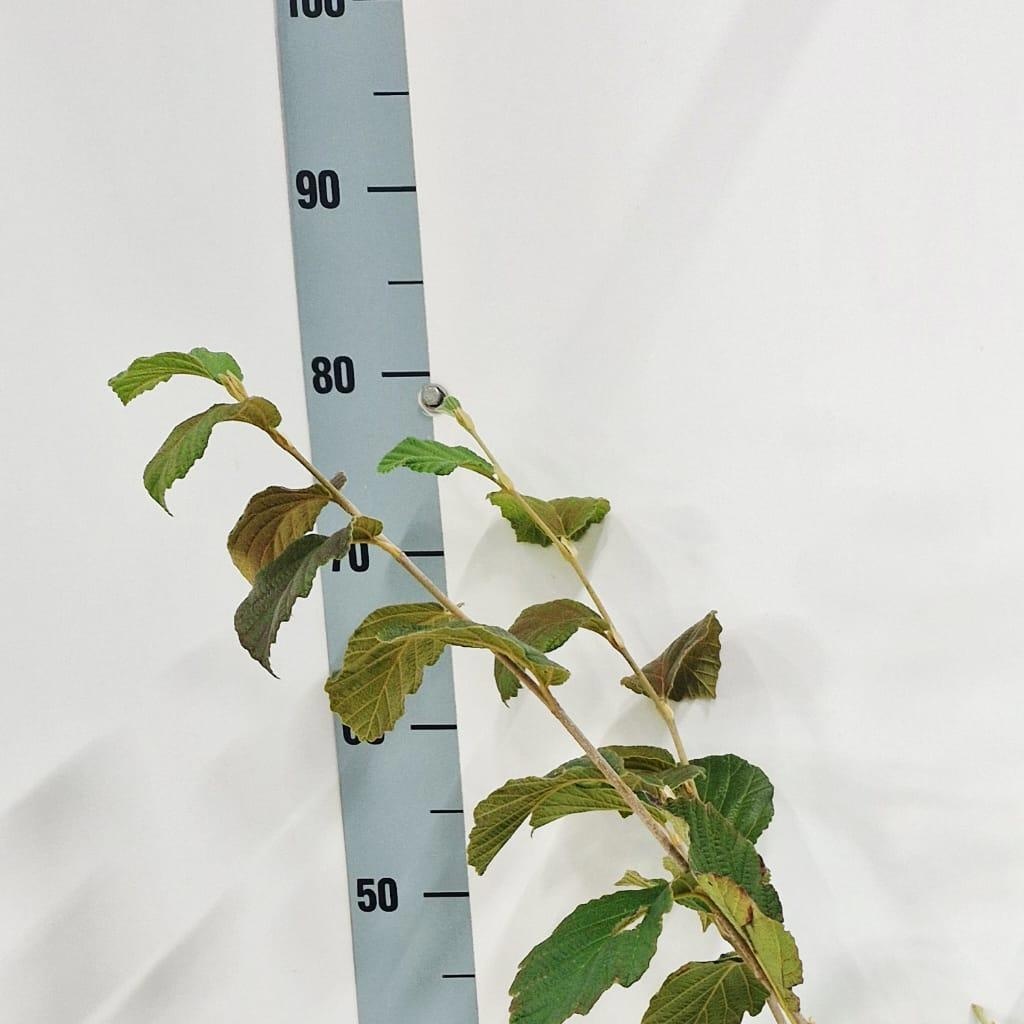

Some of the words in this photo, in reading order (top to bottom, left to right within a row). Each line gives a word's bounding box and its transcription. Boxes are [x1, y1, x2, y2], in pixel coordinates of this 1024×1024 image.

[295, 169, 341, 210] 90
[311, 356, 355, 394] 80
[356, 877, 399, 913] 50
